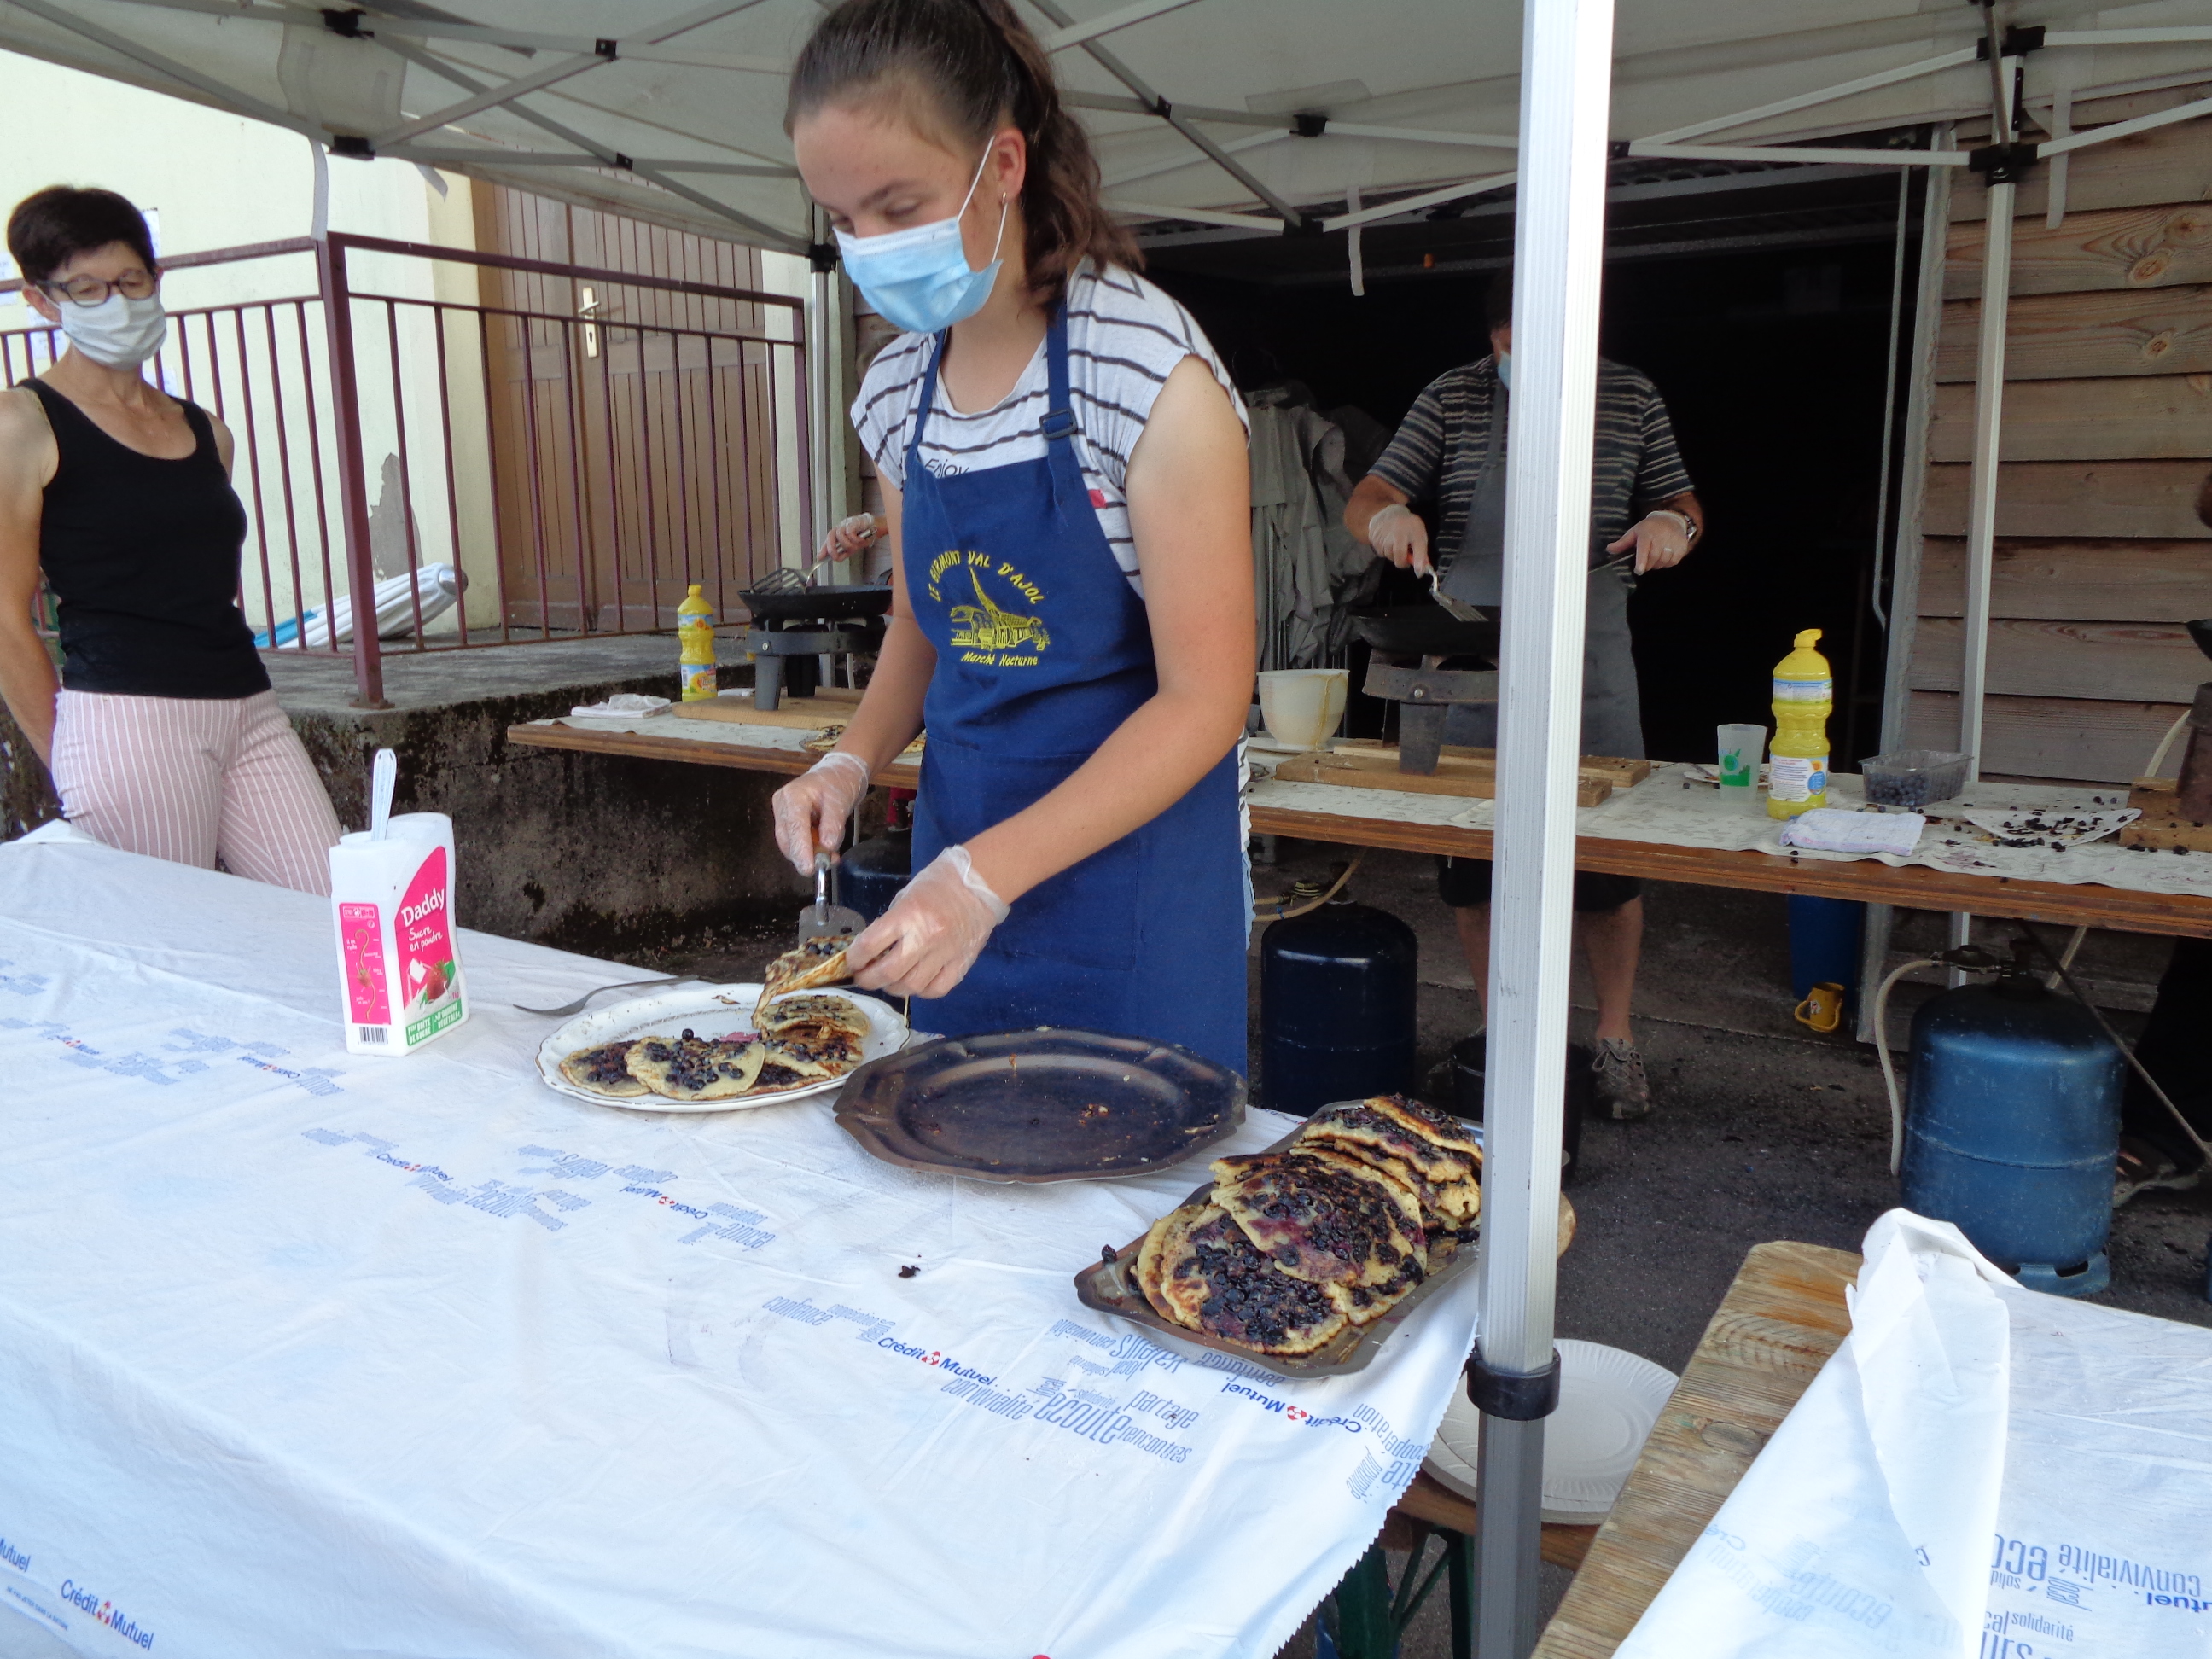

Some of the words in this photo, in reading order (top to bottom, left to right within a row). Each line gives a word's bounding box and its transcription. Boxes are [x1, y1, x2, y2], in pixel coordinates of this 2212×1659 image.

[929, 550, 960, 584] GIRMONT
[968, 550, 990, 568] VAL
[961, 651, 996, 665] Marché
[999, 655, 1039, 667] Nocturne
[401, 888, 445, 928] Daddy
[409, 926, 432, 941] Sucre
[410, 941, 420, 952] en
[421, 931, 443, 952] poudre
[762, 1296, 833, 1326] confiance
[878, 1337, 926, 1360] Crédit
[939, 1358, 998, 1385] Mutuel
[1105, 1360, 1142, 1382] local
[1109, 1334, 1188, 1374] valeurs
[940, 1377, 1037, 1420] convivialité
[1123, 1389, 1199, 1430] partage
[1220, 1382, 1286, 1413] Mutuel
[1033, 1390, 1132, 1444] écoute
[1305, 1414, 1362, 1434] Crédit
[1117, 1426, 1192, 1464] rencontres
[2059, 1544, 2201, 1598] convivialité
[61, 1579, 98, 1616] Crédit
[110, 1610, 154, 1651] Mutuel
[2011, 1612, 2074, 1642] solidarité
